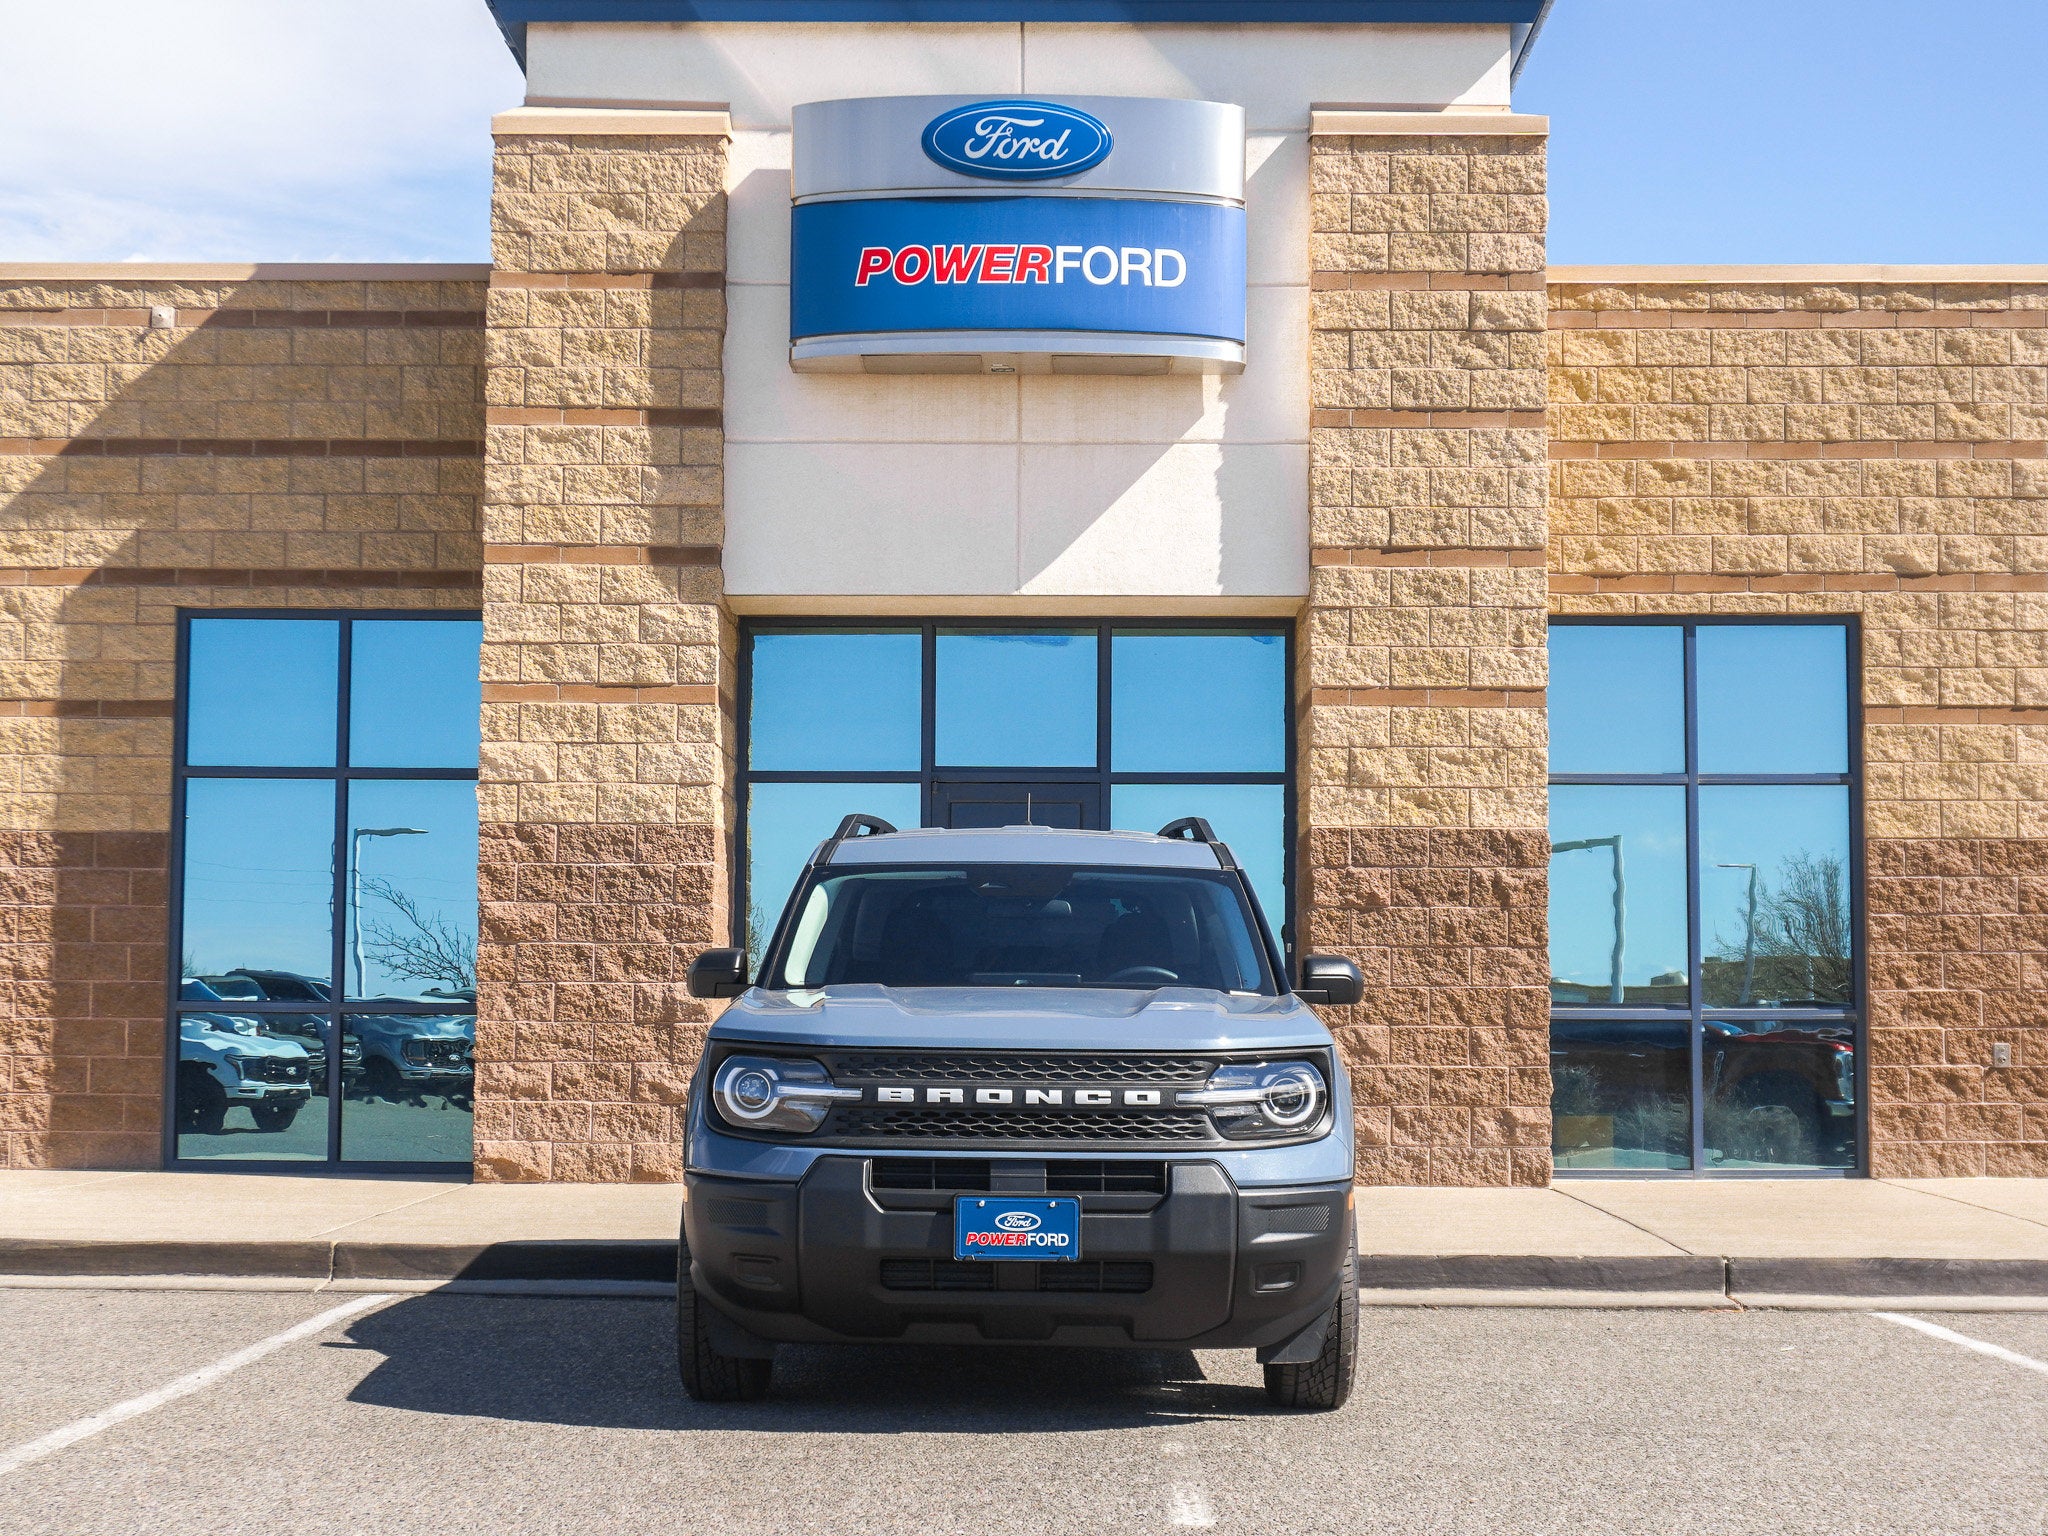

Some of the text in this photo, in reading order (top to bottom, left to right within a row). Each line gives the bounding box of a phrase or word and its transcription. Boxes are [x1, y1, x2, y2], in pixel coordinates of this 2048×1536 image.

[964, 116, 1071, 159] Ford
[877, 1087, 1161, 1105] BRONCO
[1004, 1215, 1032, 1228] Ford
